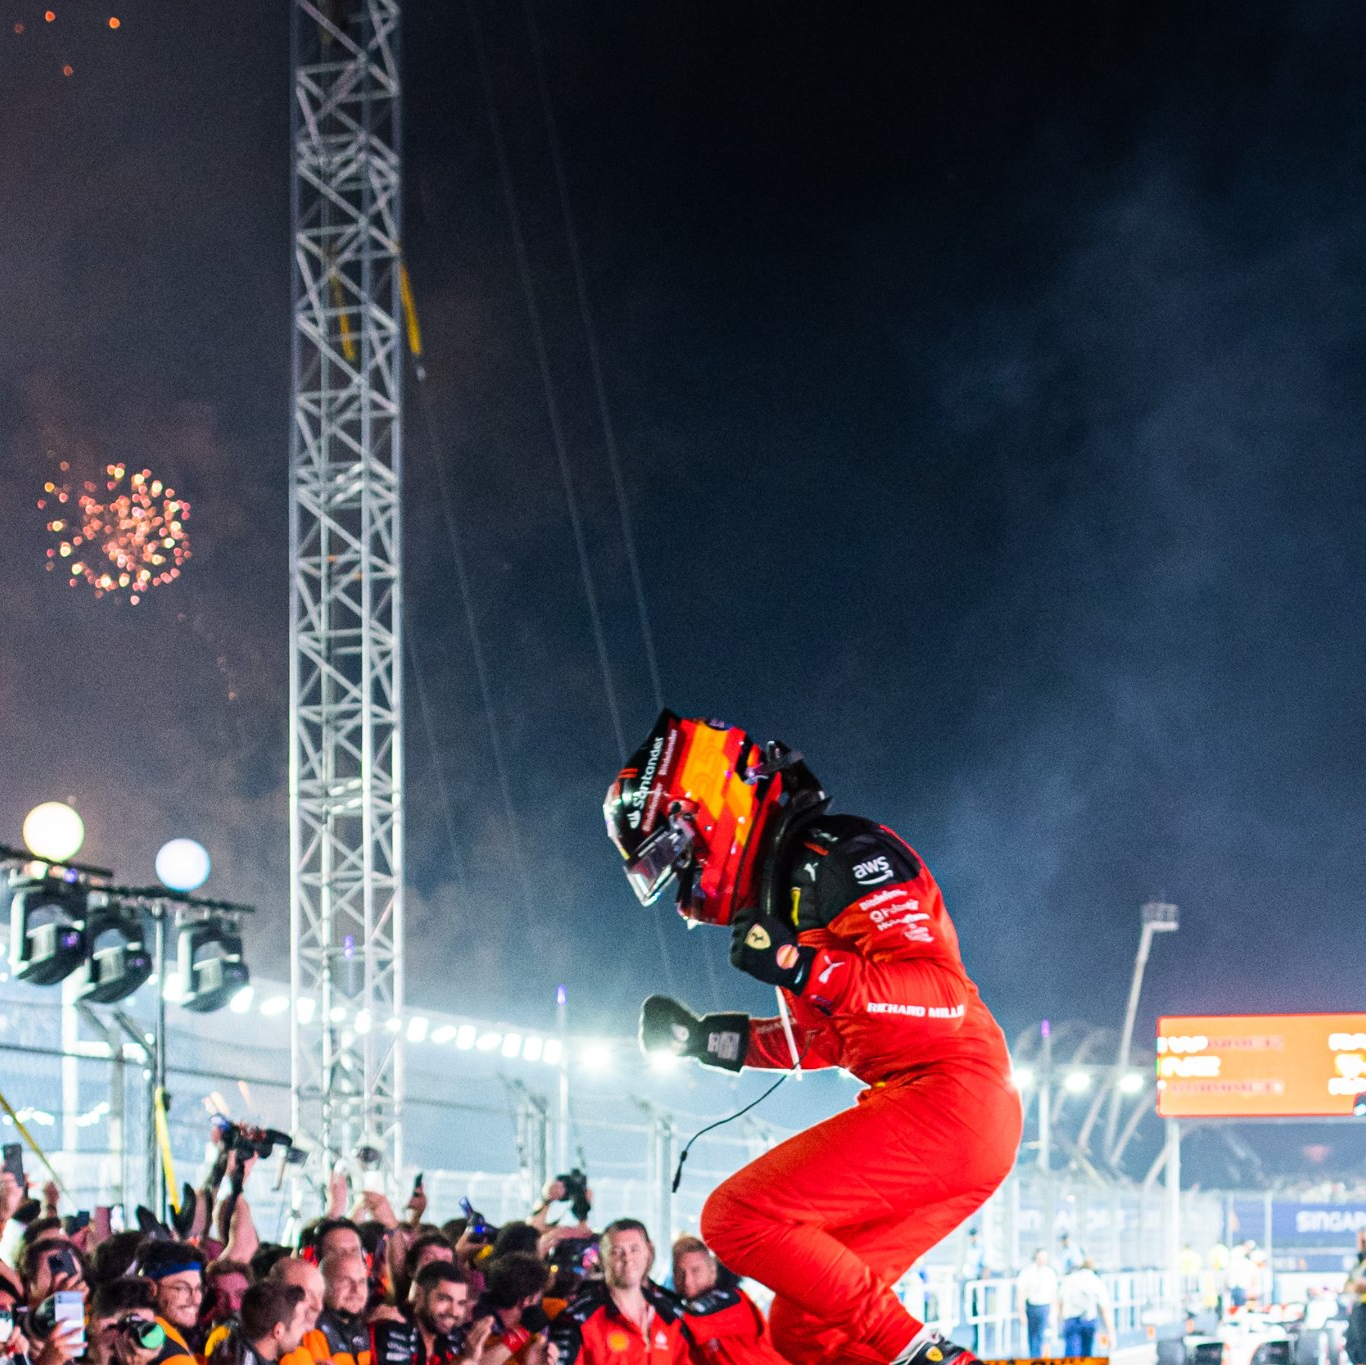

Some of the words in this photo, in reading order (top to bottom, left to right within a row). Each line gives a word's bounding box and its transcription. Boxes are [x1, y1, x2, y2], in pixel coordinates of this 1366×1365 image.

[632, 736, 664, 810] Santander
[852, 856, 891, 881] aws
[867, 1002, 926, 1017] RICHARD
